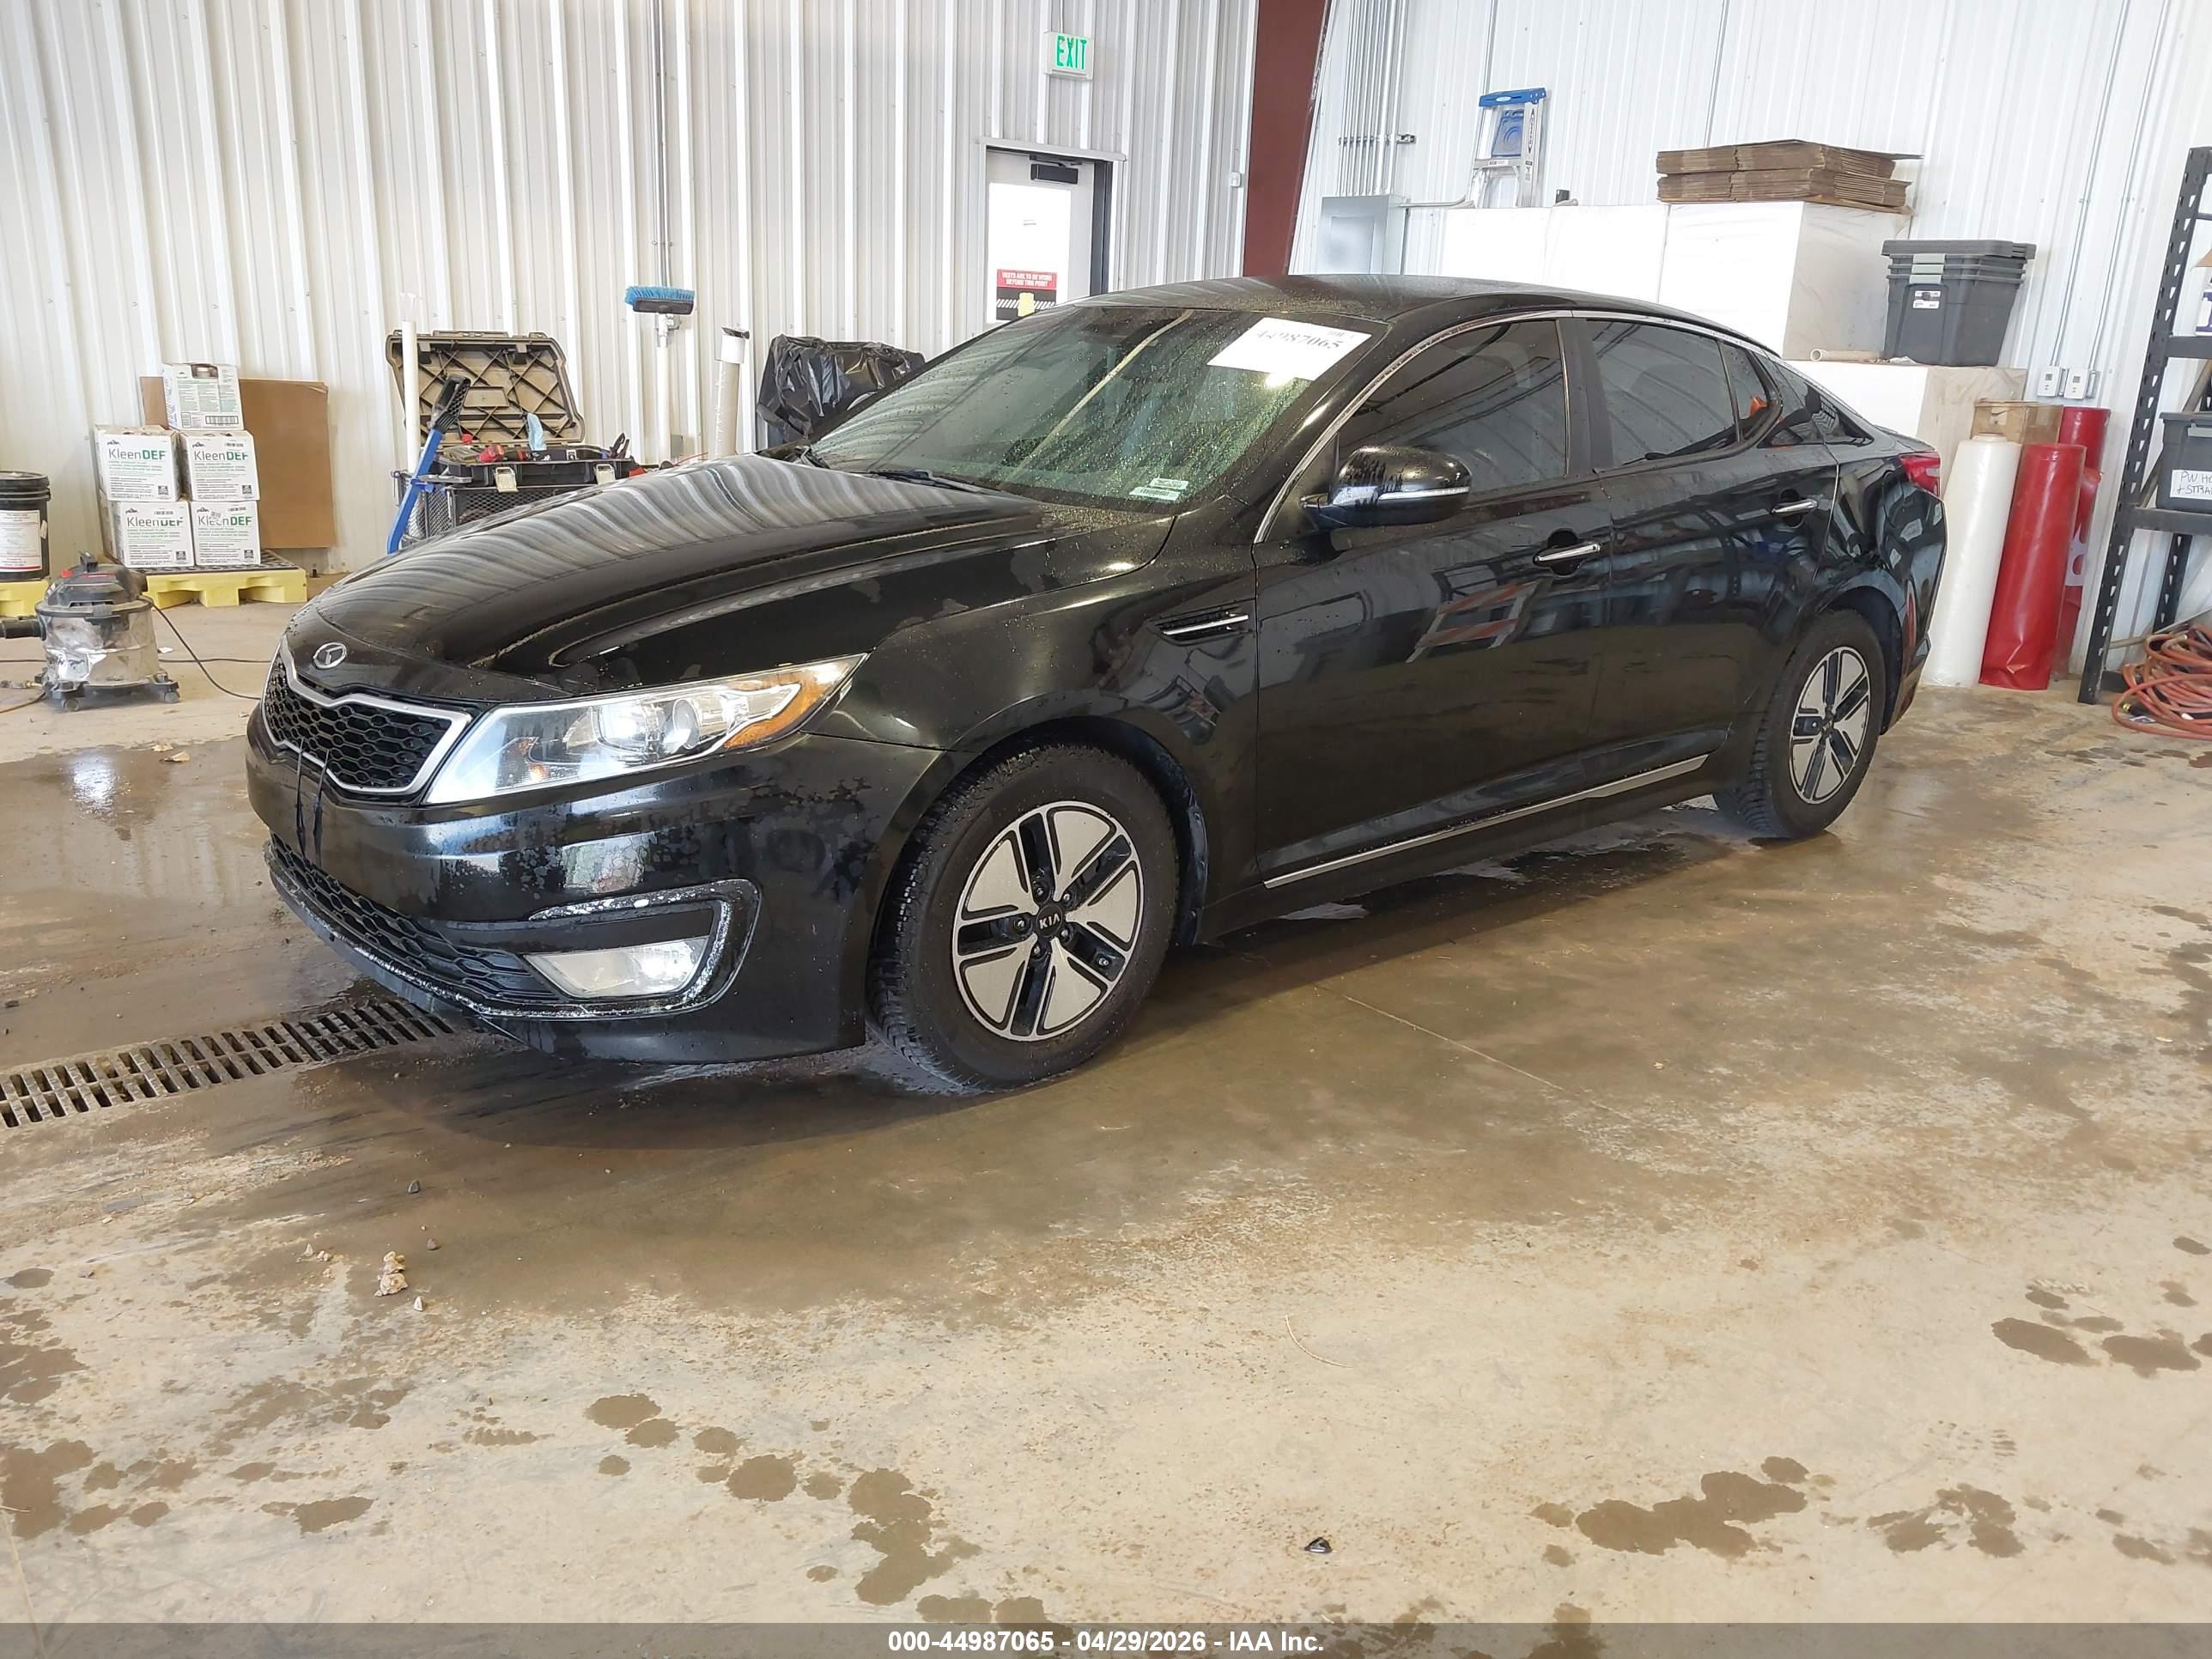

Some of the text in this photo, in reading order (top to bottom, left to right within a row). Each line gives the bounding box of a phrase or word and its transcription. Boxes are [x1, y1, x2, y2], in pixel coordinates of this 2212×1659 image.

[1056, 35, 1087, 70] EXIT
[108, 448, 166, 460] KleenDEF
[194, 451, 248, 461] KleenDEF
[1039, 913, 1060, 930] KIA
